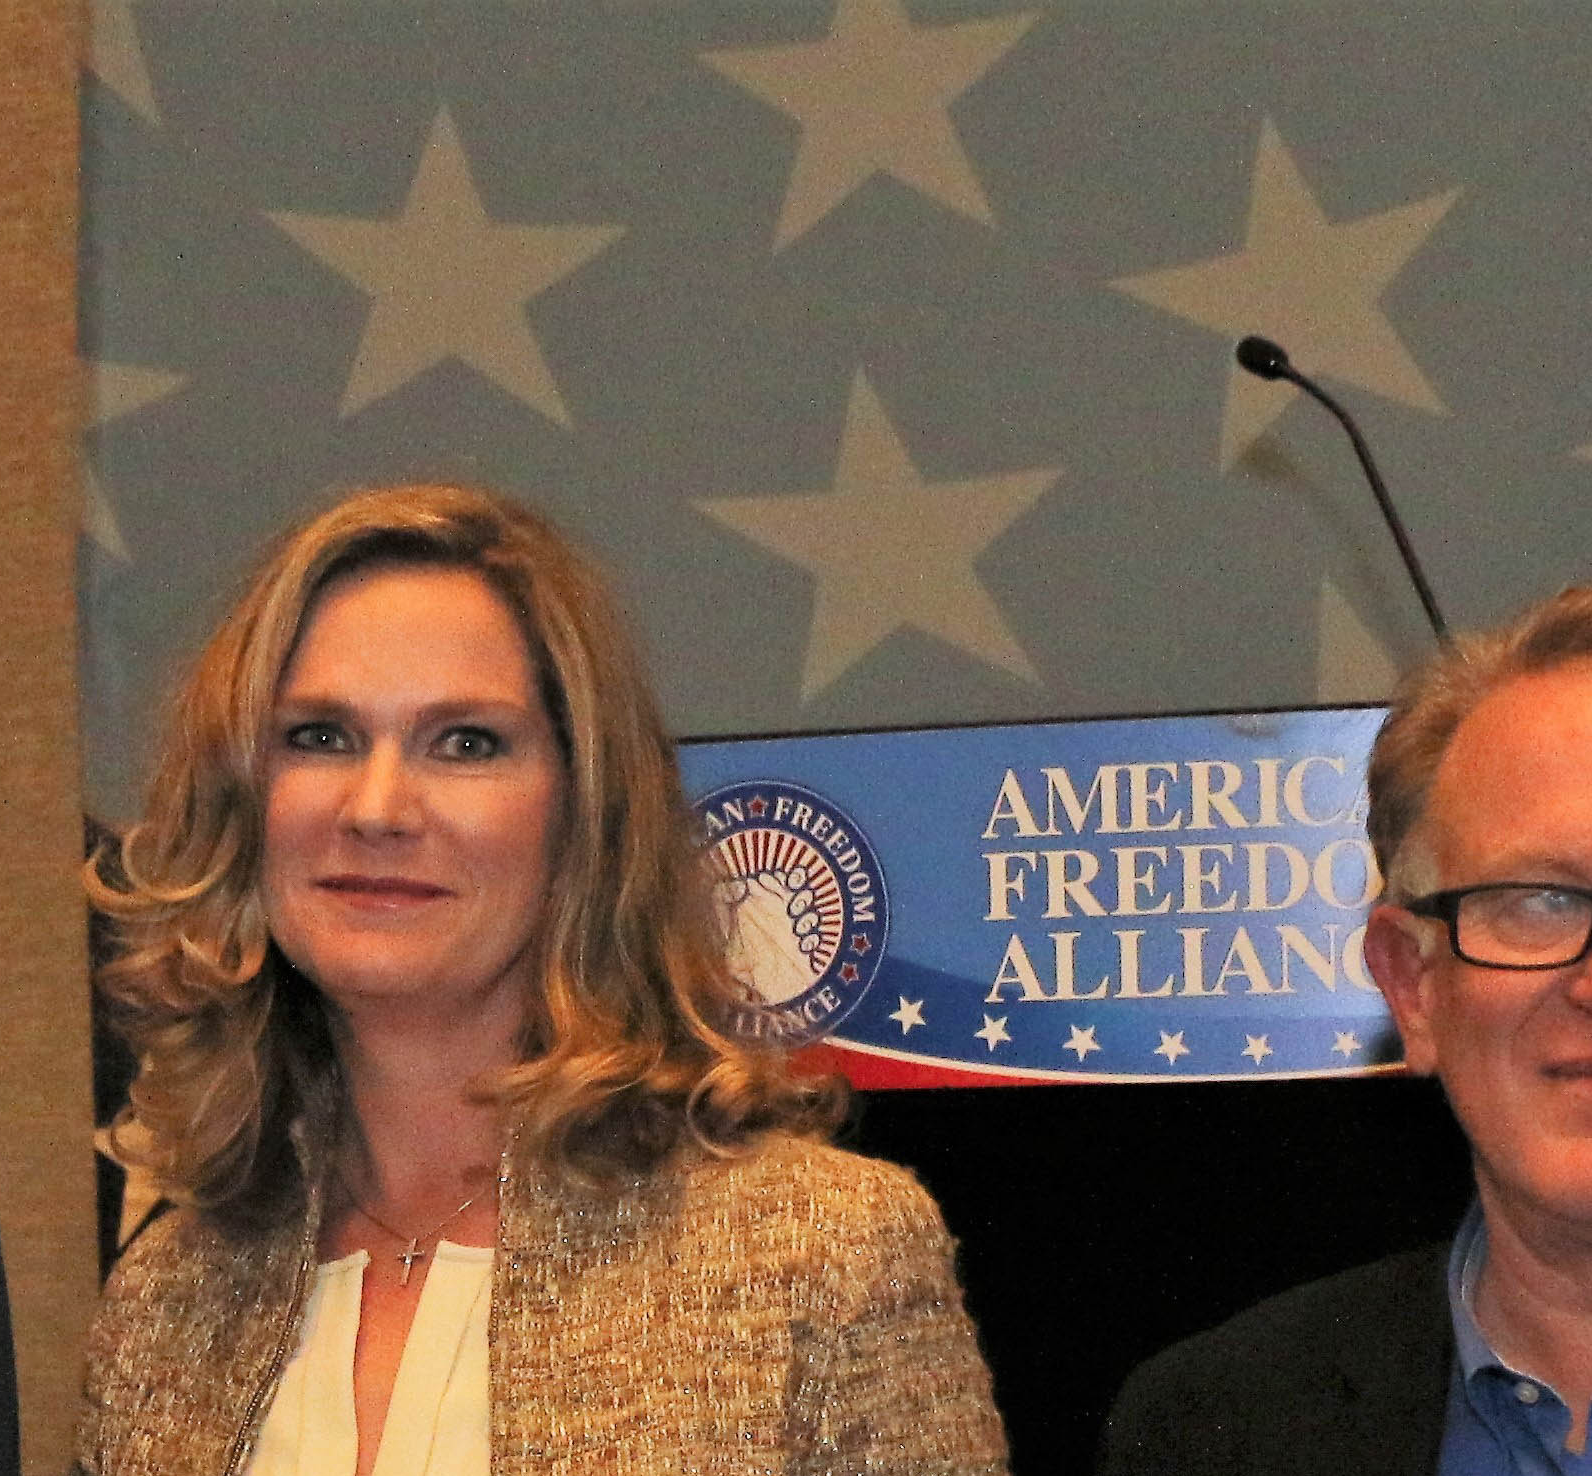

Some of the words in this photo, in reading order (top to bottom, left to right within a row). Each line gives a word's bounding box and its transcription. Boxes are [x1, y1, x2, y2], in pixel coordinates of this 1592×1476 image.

[981, 755, 1371, 839] AMERIC
[774, 796, 876, 923] FREEDOM
[981, 839, 1386, 921] FREEDO
[984, 923, 1383, 1003] ALLIANC
